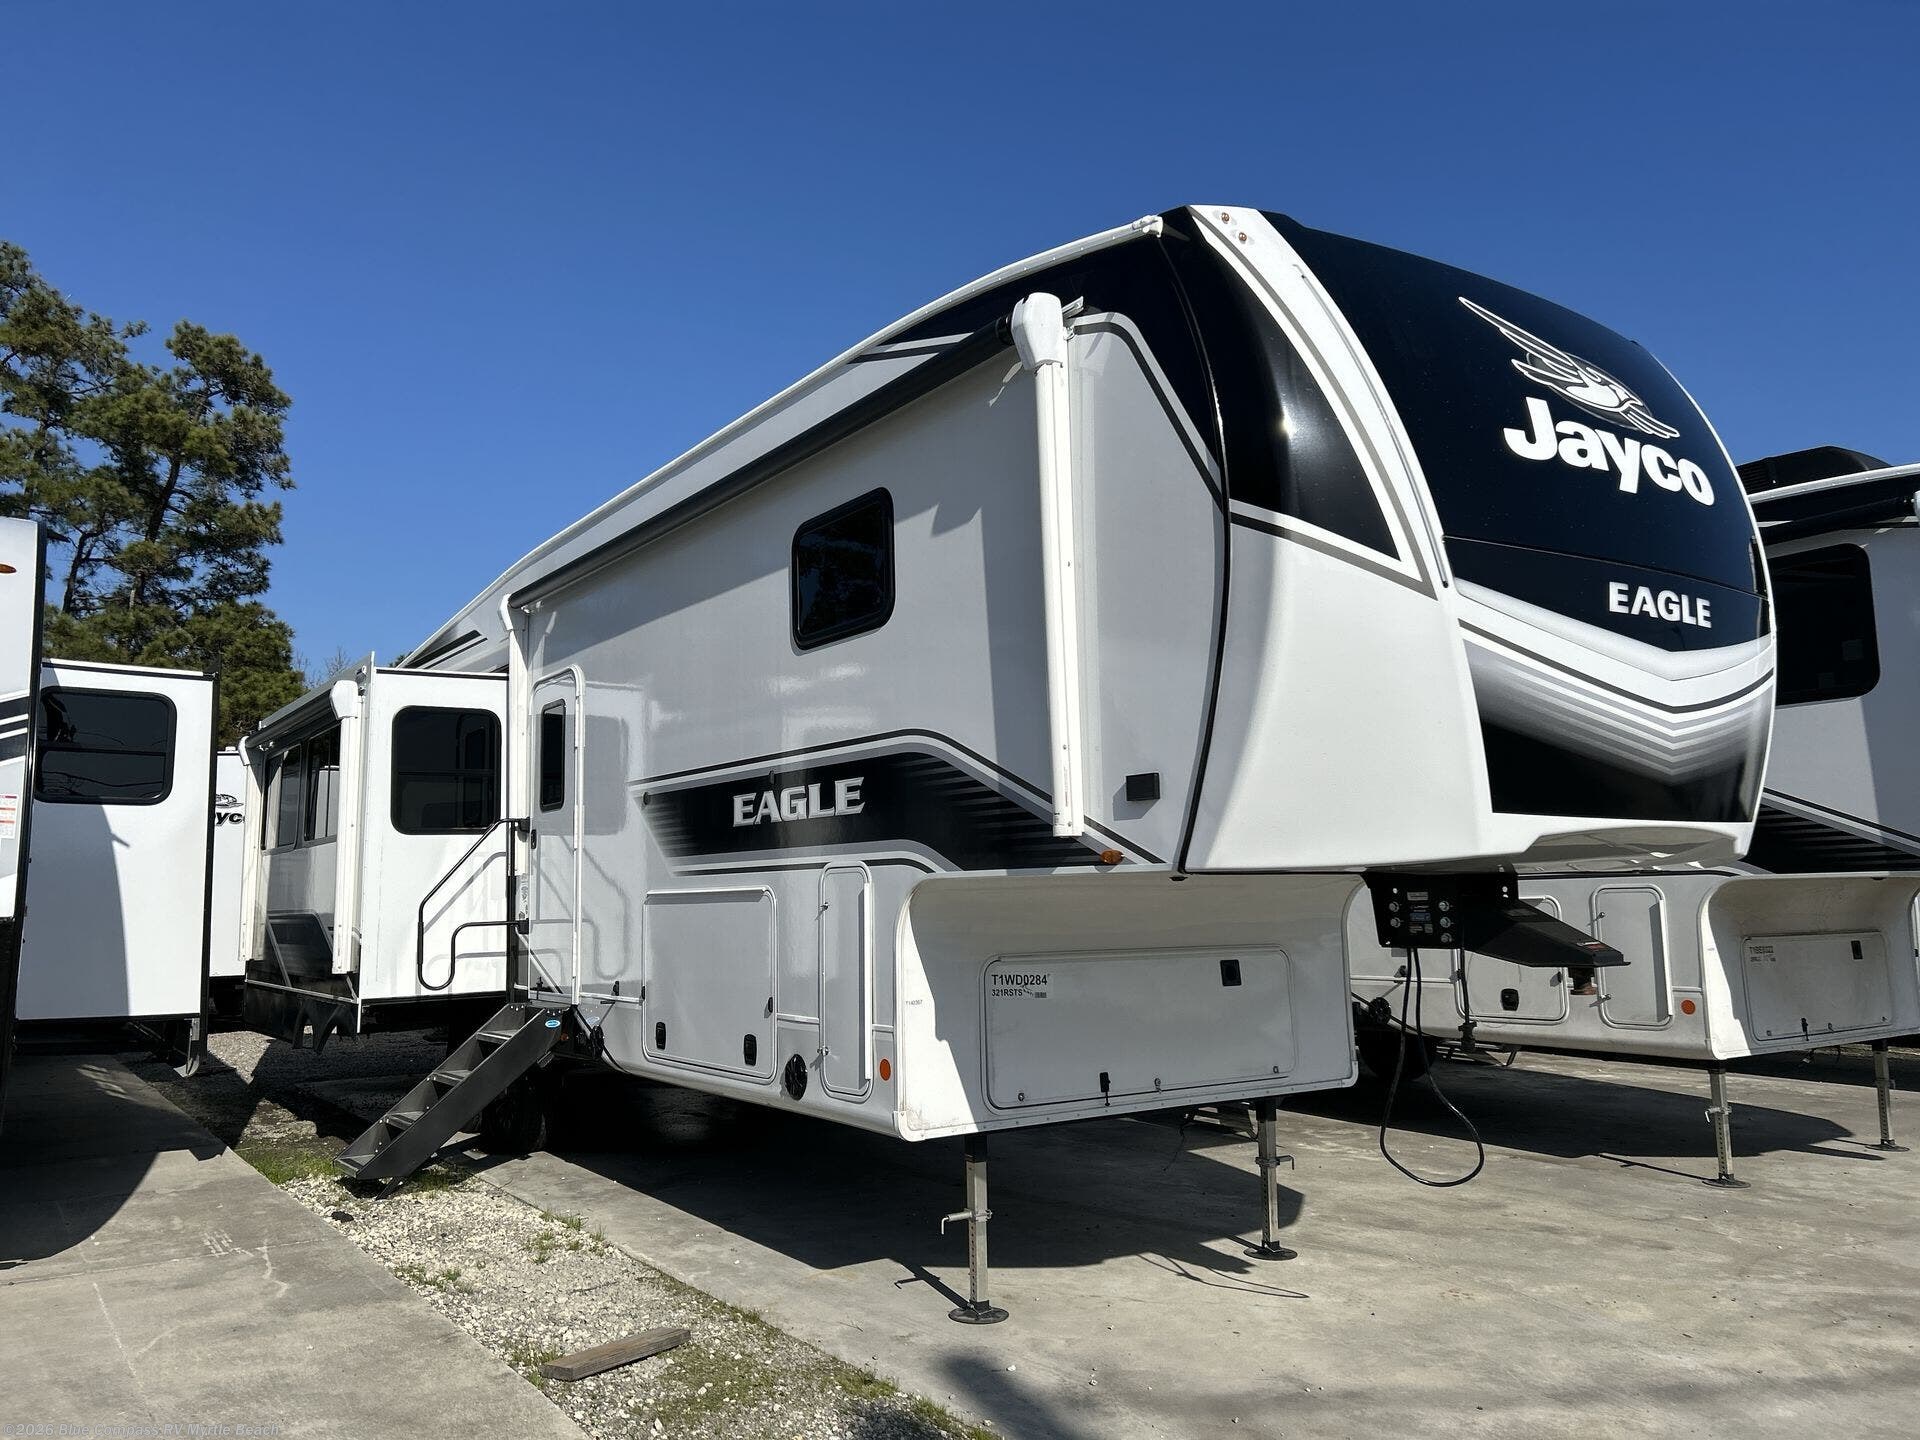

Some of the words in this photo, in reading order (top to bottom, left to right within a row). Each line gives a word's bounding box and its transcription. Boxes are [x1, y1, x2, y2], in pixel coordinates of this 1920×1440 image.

[1503, 396, 1715, 506] Jayco
[1608, 581, 1712, 629] EAGLE
[733, 777, 865, 827] EAGLE
[991, 974, 1048, 985] T1WD0284
[991, 988, 1023, 997] 321RSTS
